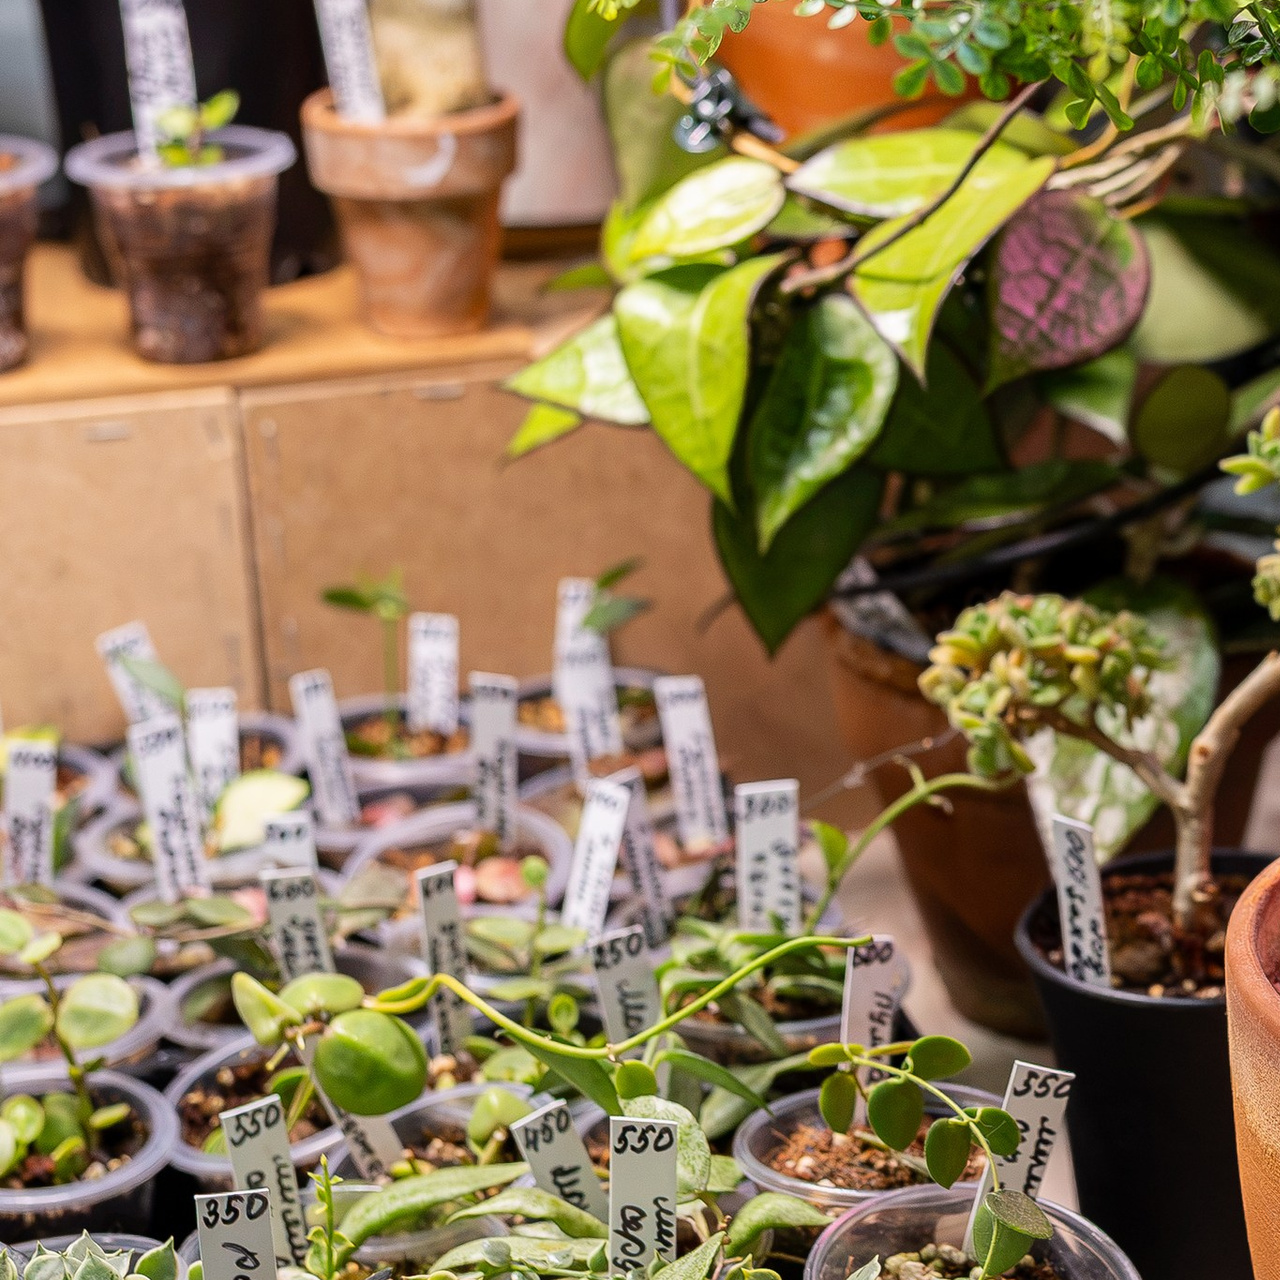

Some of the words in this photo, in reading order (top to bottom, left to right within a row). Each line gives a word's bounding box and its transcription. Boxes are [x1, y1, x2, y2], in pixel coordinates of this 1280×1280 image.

[1013, 1070, 1072, 1099] 550
[229, 1103, 281, 1148] 550
[523, 1109, 571, 1153] 450
[613, 1124, 675, 1155] 550
[202, 1192, 270, 1229] 350
